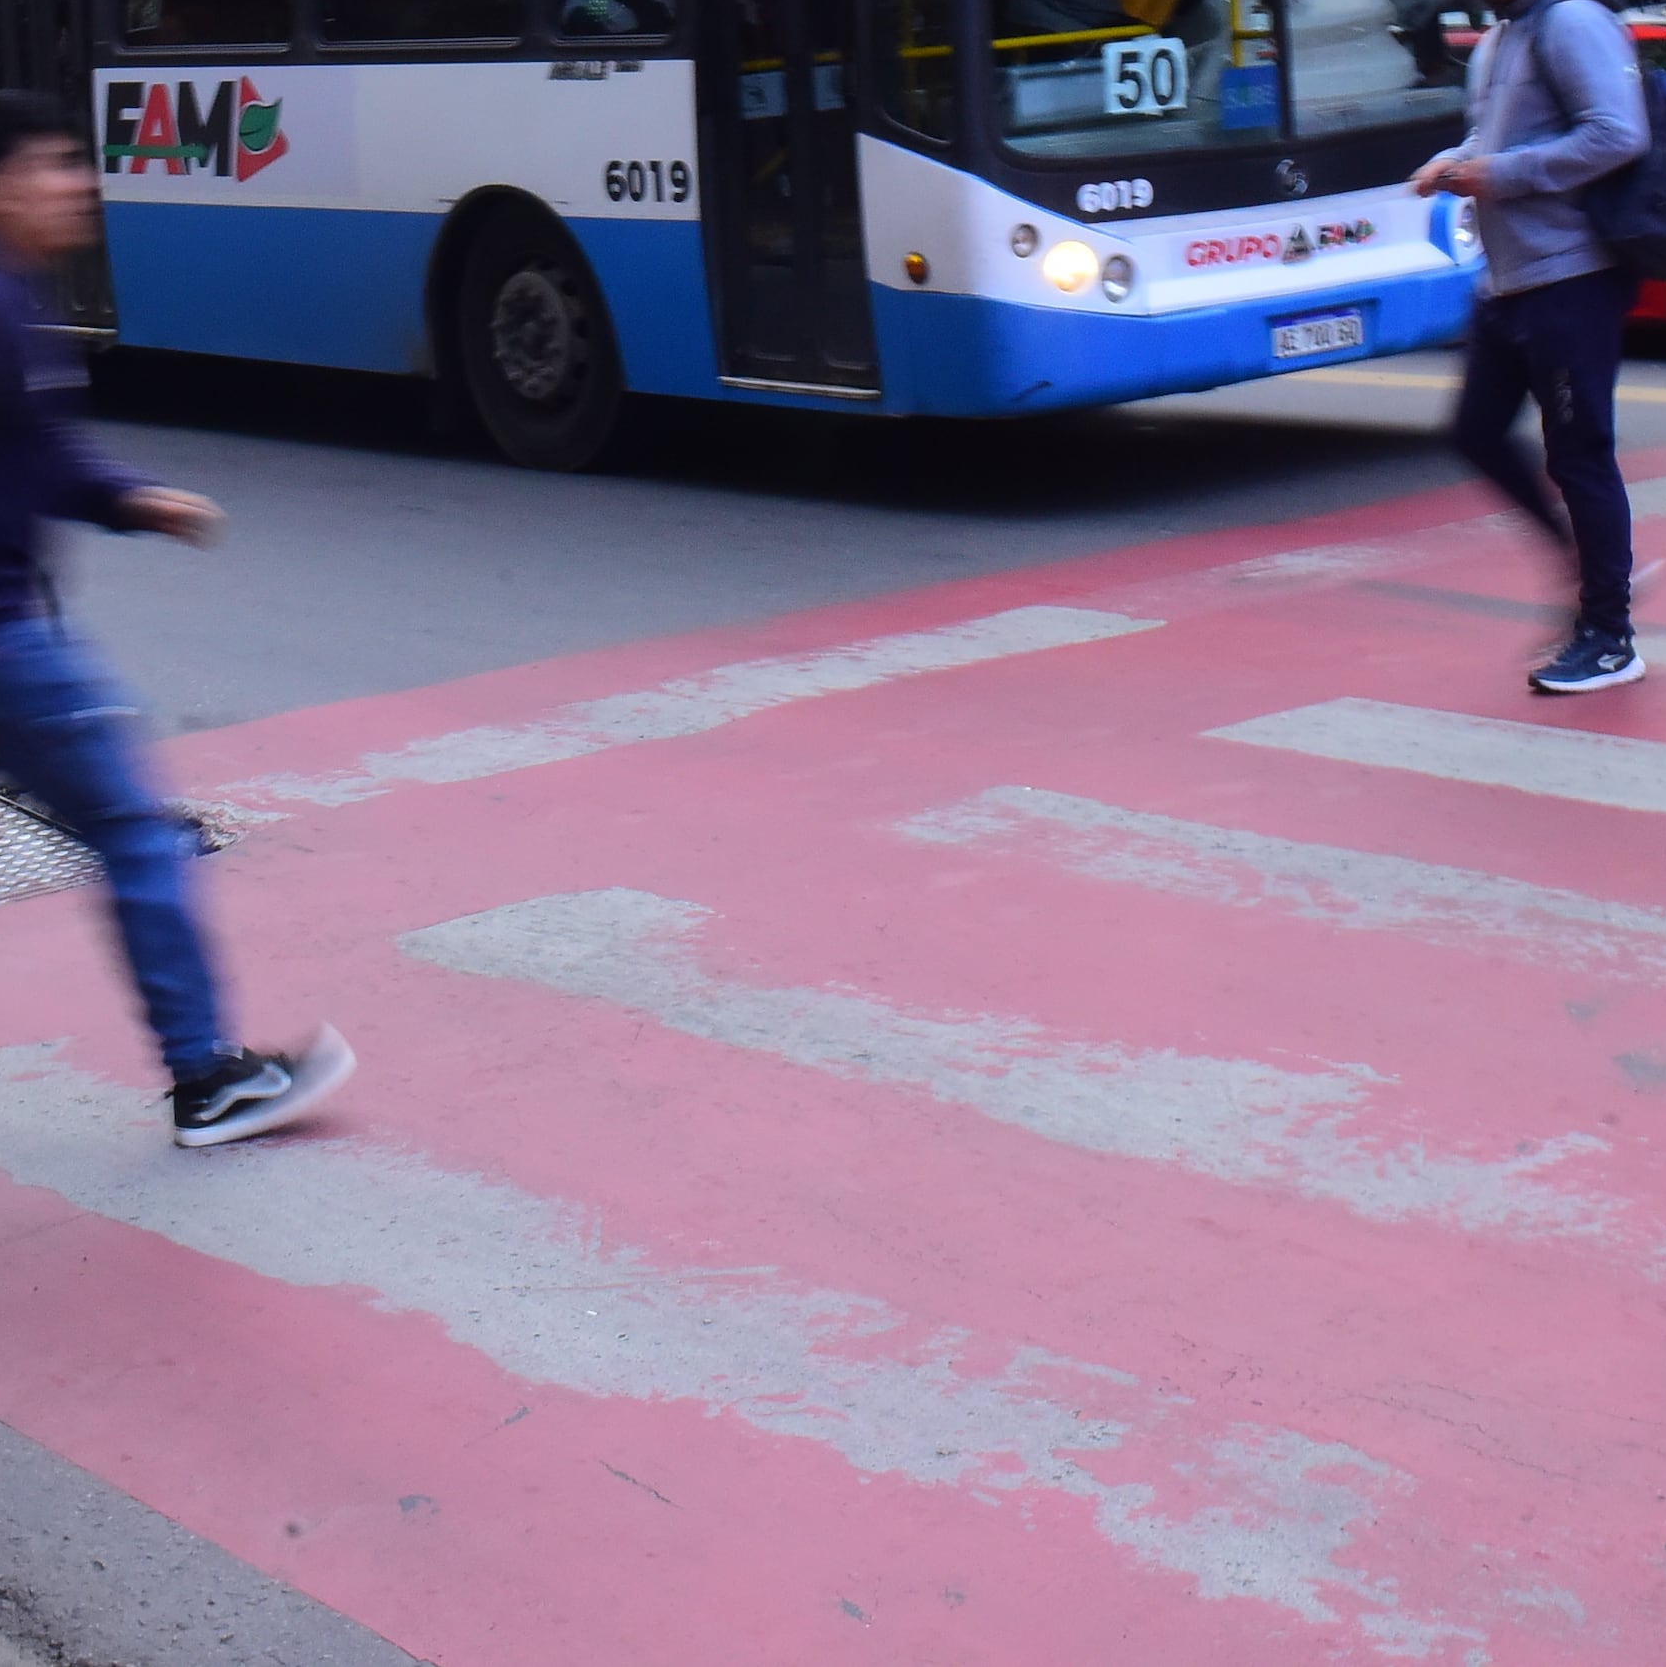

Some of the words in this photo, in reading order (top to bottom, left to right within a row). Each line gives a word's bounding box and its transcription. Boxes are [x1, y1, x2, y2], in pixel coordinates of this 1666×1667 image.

[1117, 48, 1176, 109] 50
[104, 79, 239, 177] FAM
[606, 159, 691, 203] 6019
[1076, 177, 1155, 214] 6019
[1184, 233, 1283, 267] GRUPO
